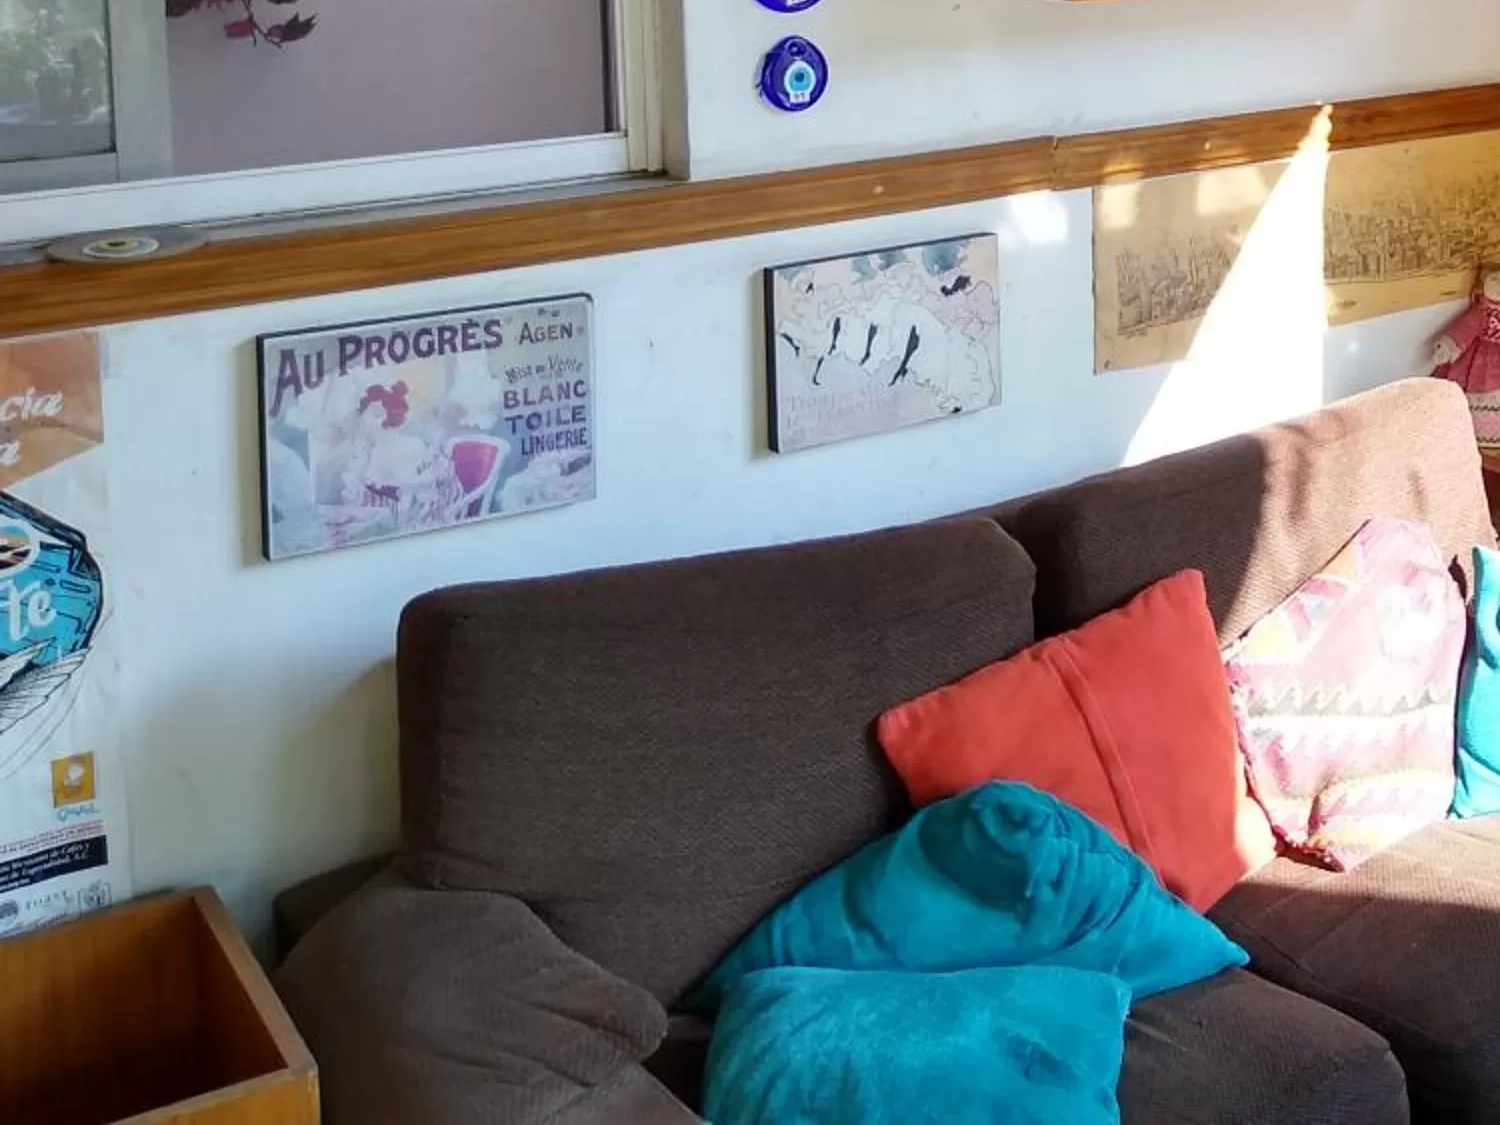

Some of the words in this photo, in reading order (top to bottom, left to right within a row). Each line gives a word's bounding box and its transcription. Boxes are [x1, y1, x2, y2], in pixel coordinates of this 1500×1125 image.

[503, 379, 587, 411] BLANC
[503, 405, 587, 435] TOILE
[520, 427, 588, 457] LINGERIE
